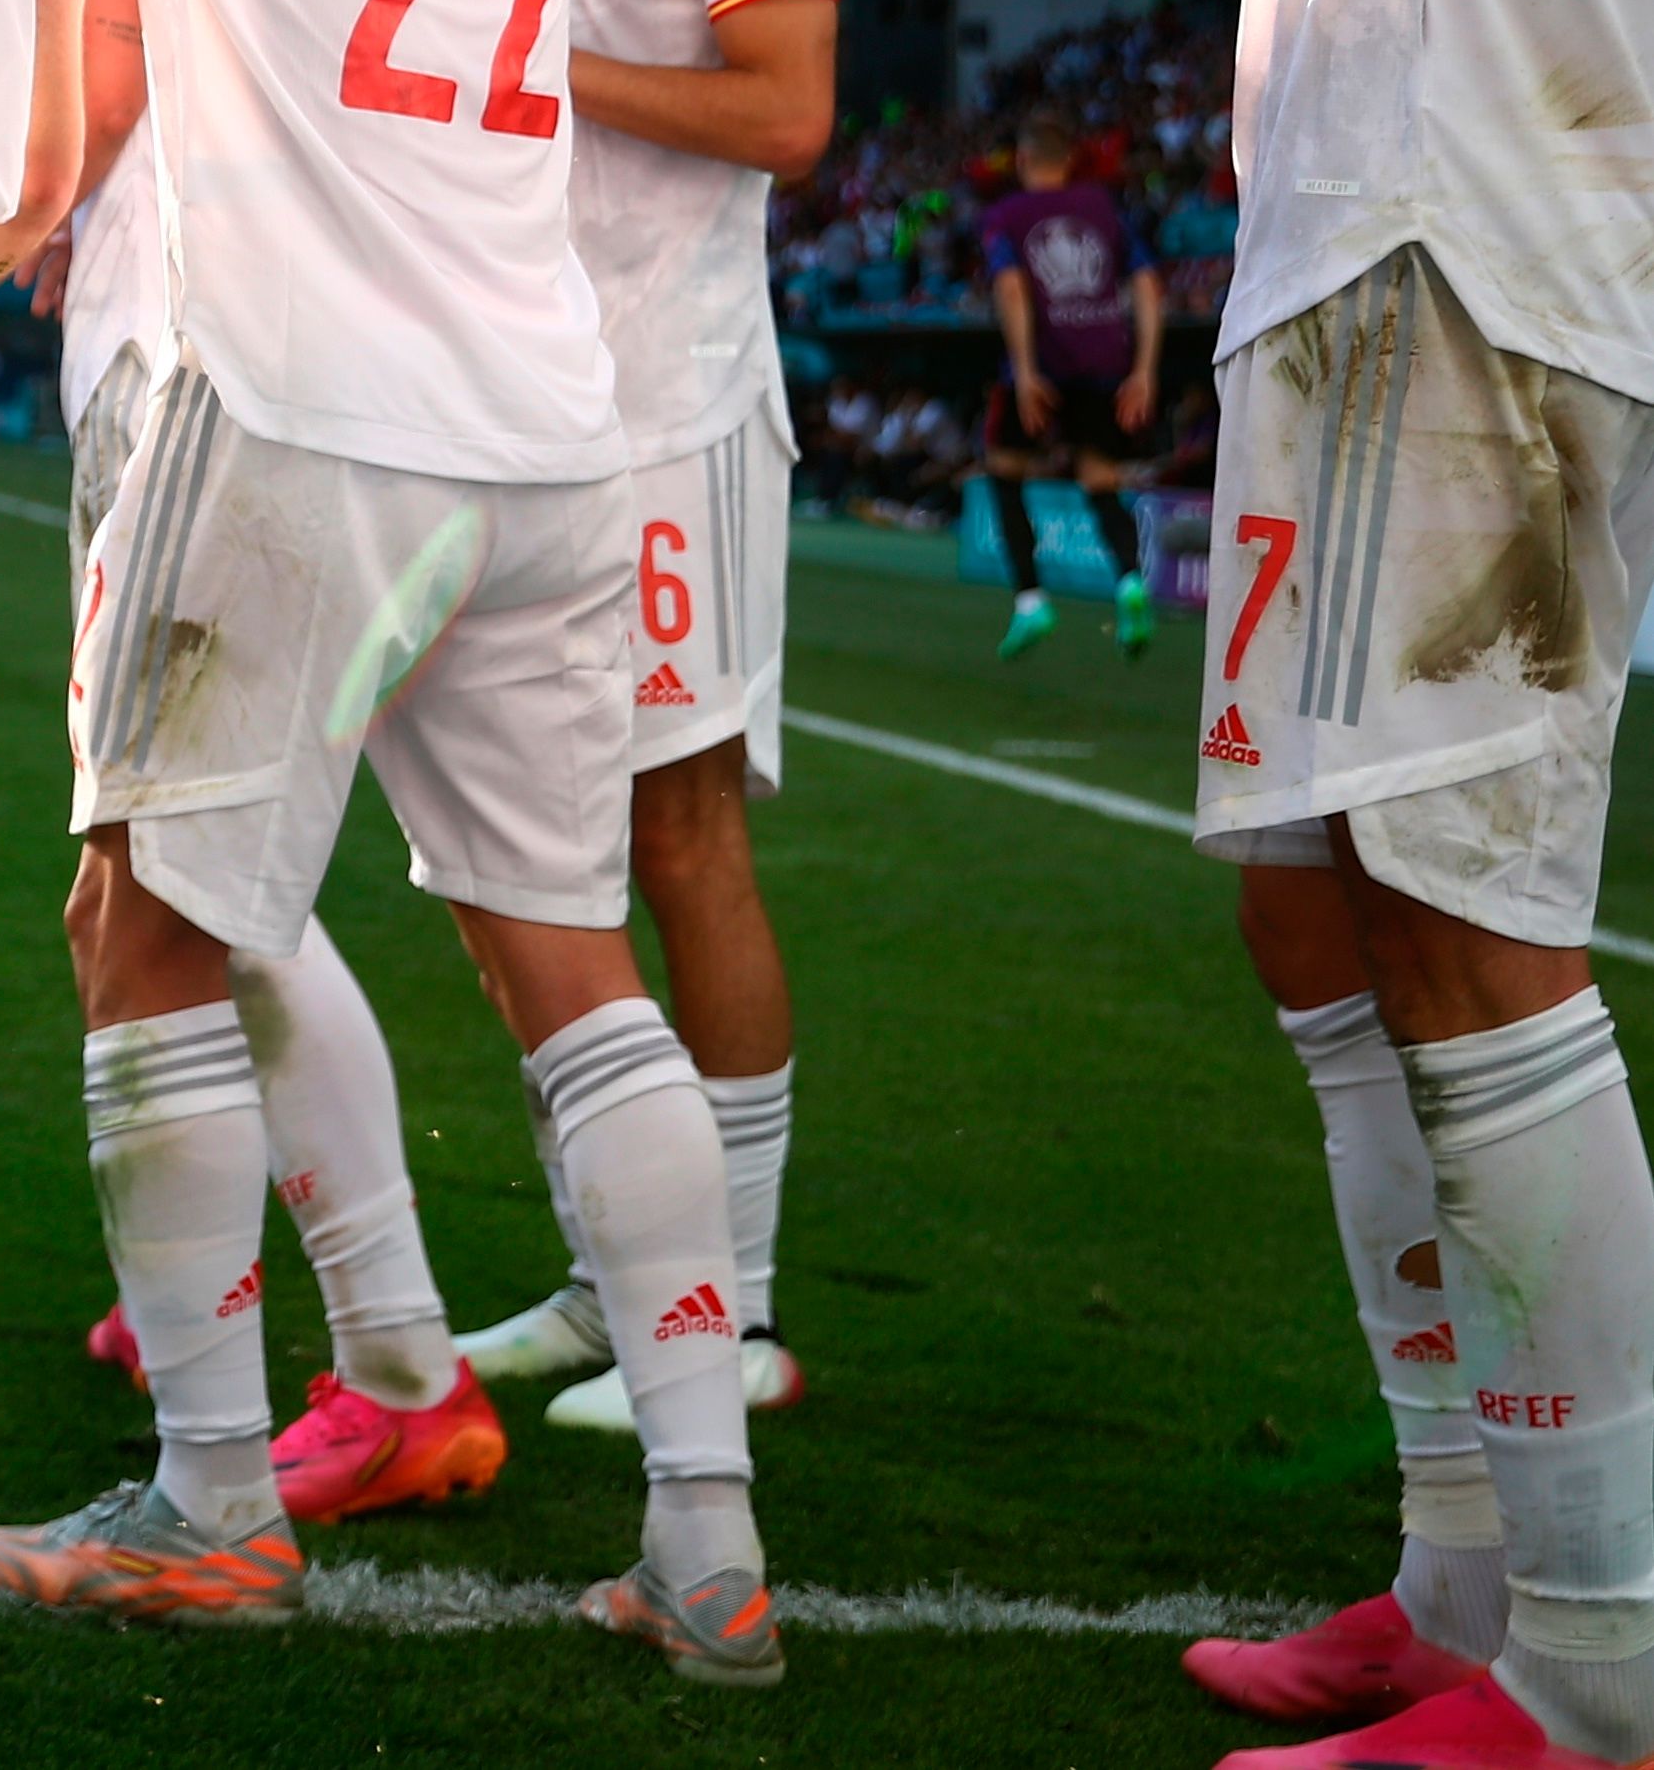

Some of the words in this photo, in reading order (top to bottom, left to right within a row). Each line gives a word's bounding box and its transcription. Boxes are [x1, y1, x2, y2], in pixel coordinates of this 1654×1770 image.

[638, 521, 691, 644] 6
[1224, 514, 1296, 680] 7
[654, 1316, 734, 1343] adidas
[1475, 1389, 1575, 1429] RFEF
